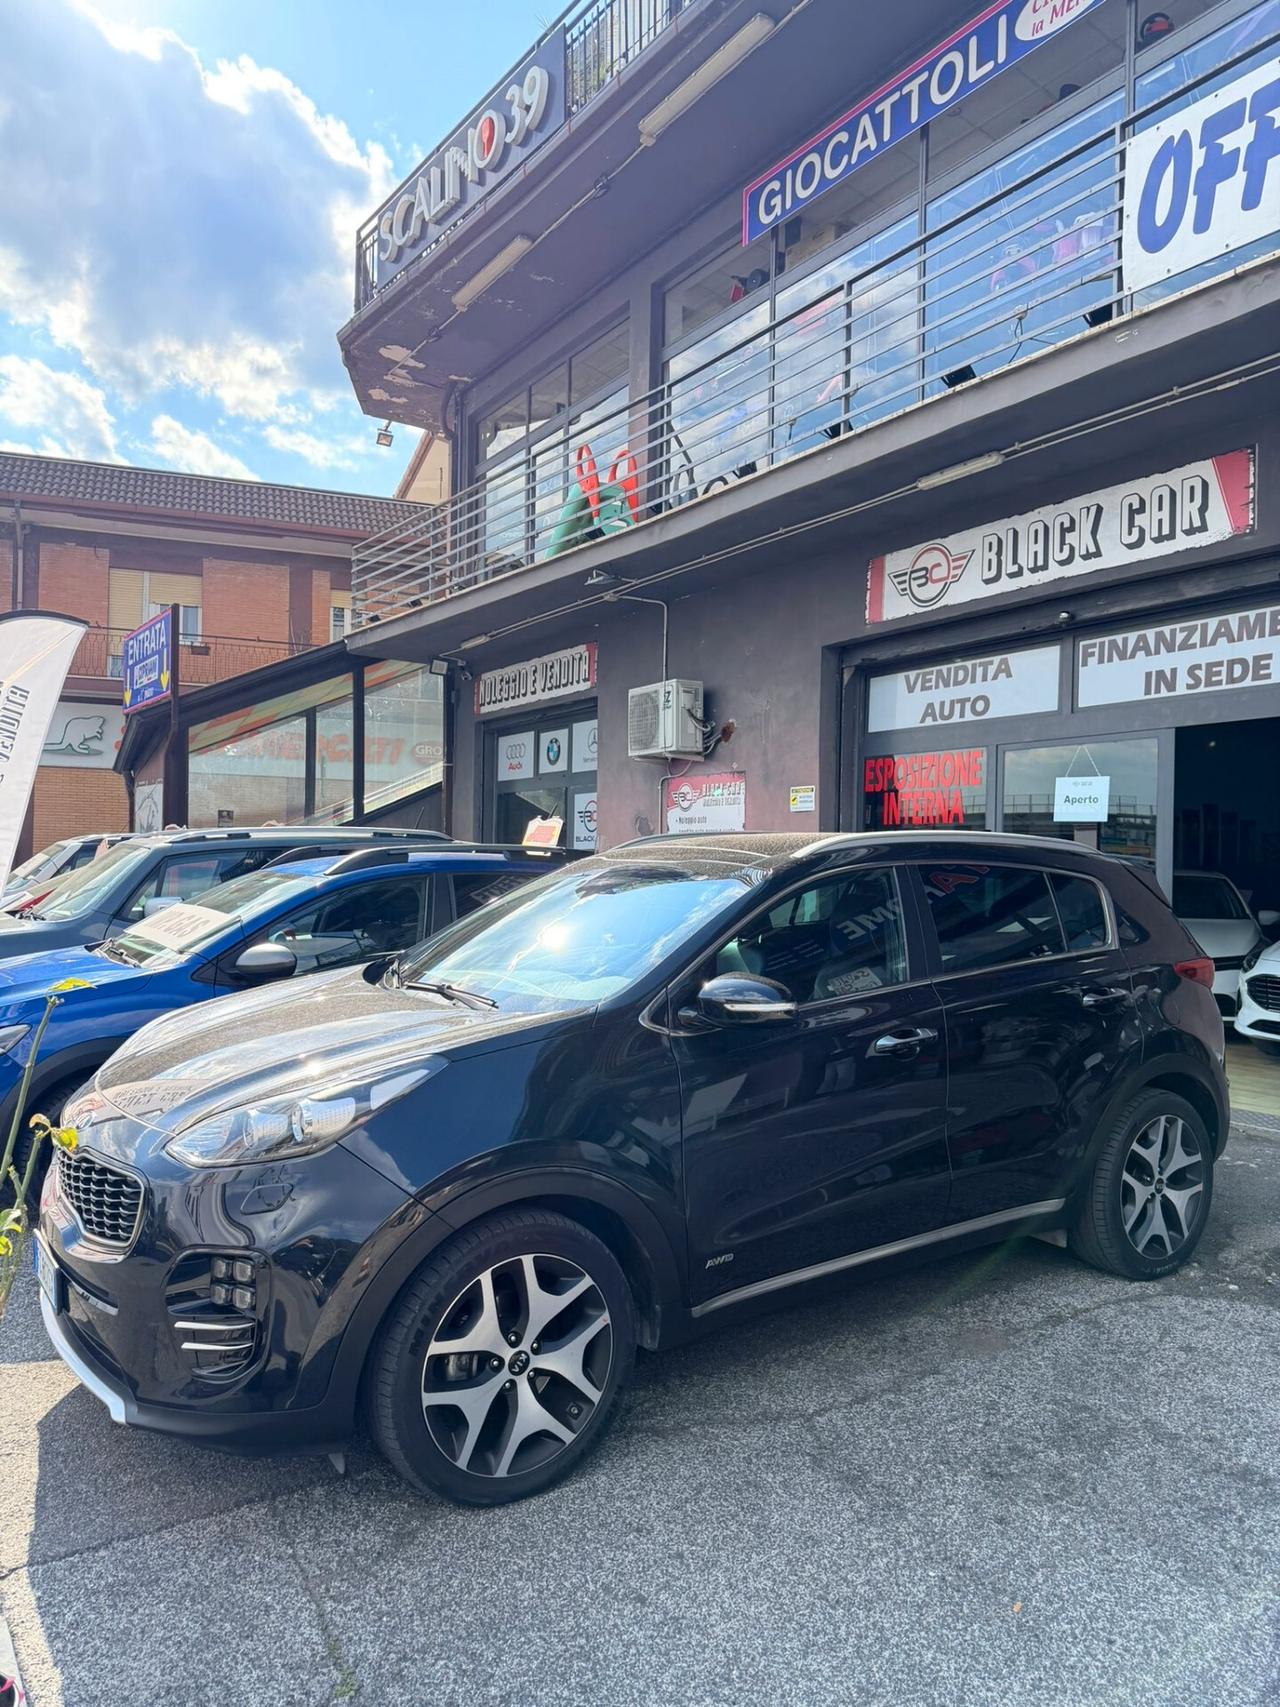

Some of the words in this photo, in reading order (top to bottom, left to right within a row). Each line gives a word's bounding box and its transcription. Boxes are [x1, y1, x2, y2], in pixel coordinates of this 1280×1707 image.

[758, 14, 1007, 224] GIOCATTOLI
[379, 109, 506, 264] SCALINO
[505, 65, 549, 146] 39
[981, 503, 1103, 586] BLACK
[1120, 474, 1209, 551] CAR
[128, 619, 167, 667] ENTRATA
[479, 667, 528, 707] NOLEGGIO
[530, 664, 537, 696] E
[540, 650, 590, 693] VENDITA
[904, 656, 1013, 694] VENDITA
[1143, 666, 1178, 696] IN
[1185, 653, 1273, 690] SEDE
[920, 694, 990, 724] AUTO
[865, 751, 983, 792] ESPOSIZIONE
[883, 790, 965, 825] INTERNA
[1063, 795, 1099, 806] Aperto
[705, 1253, 734, 1270] AWD
